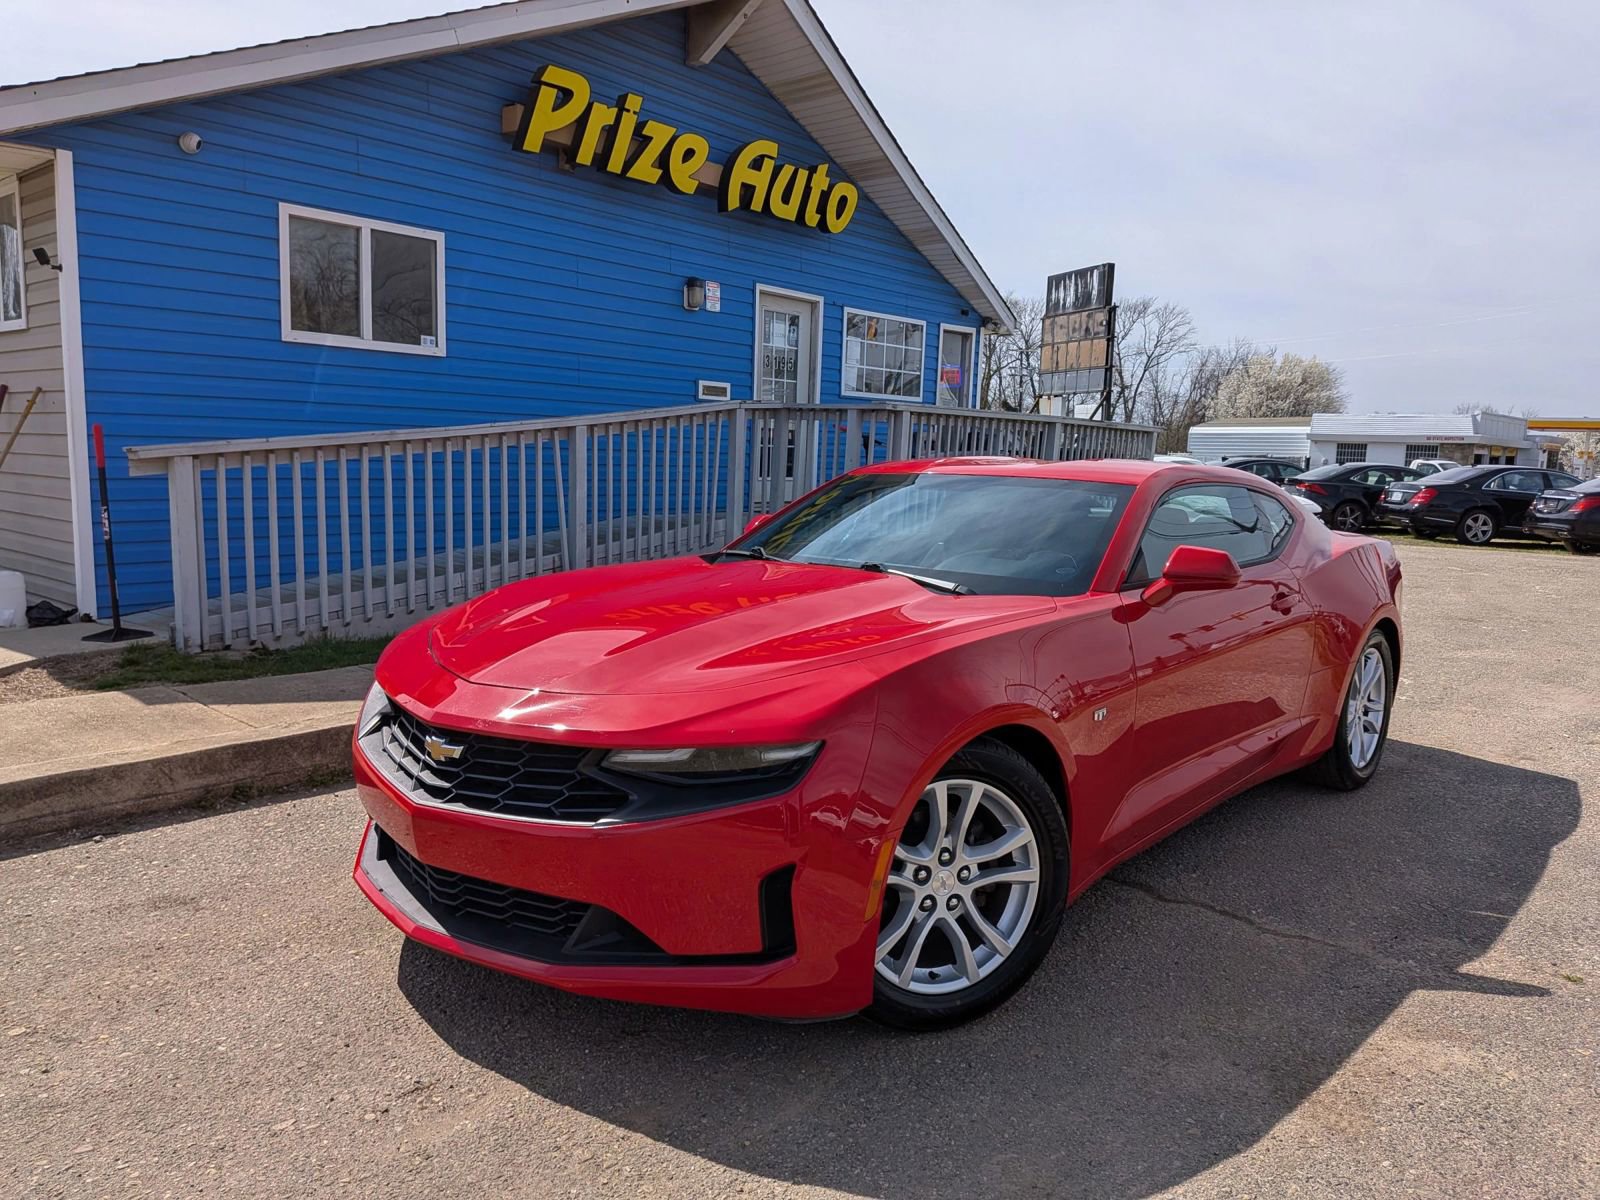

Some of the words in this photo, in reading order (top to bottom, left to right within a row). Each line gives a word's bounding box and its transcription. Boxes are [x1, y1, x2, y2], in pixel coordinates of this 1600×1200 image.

[520, 64, 710, 195] Prize
[724, 139, 859, 234] Auto
[764, 354, 794, 371] 3195
